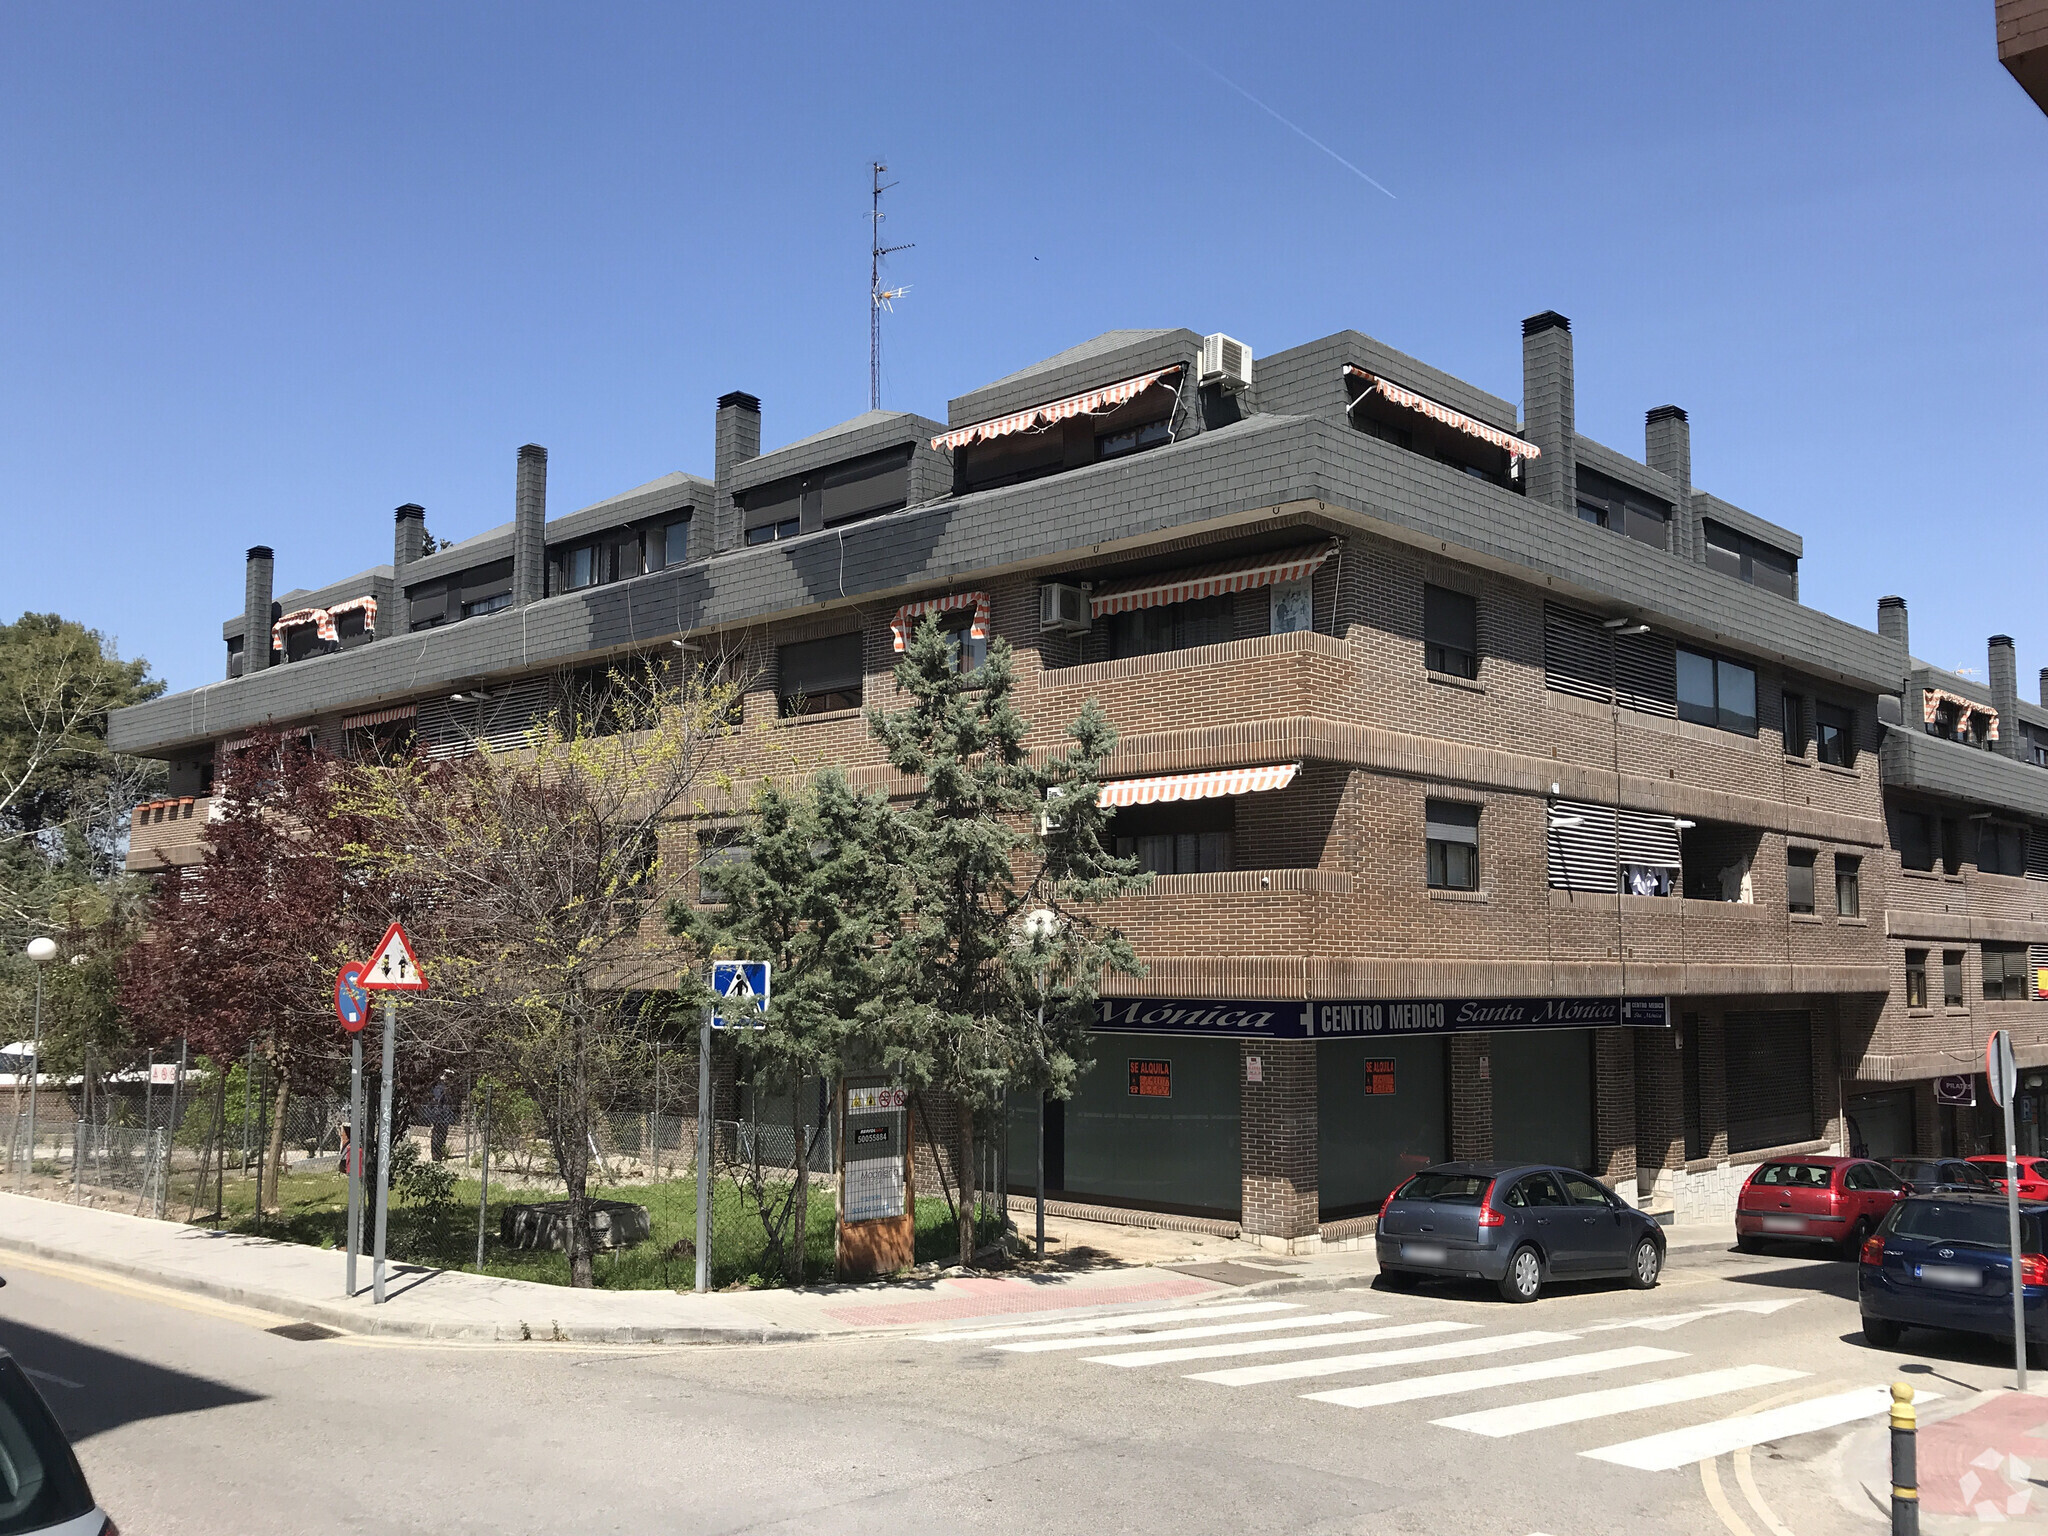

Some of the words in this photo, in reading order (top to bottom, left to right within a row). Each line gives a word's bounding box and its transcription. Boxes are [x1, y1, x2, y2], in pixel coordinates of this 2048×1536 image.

[1094, 1001, 1275, 1028] Mónica
[1321, 1005, 1383, 1032] CENTRO
[1389, 1003, 1445, 1029] MEDICO
[1456, 1001, 1523, 1022] Santa
[1532, 1000, 1616, 1022] Mónica
[1130, 1062, 1139, 1073] SE
[1140, 1062, 1169, 1075] ALQUILA
[1365, 1061, 1373, 1073] SE
[1373, 1061, 1394, 1073] ALQUILA
[1946, 1082, 1971, 1090] PILATES
